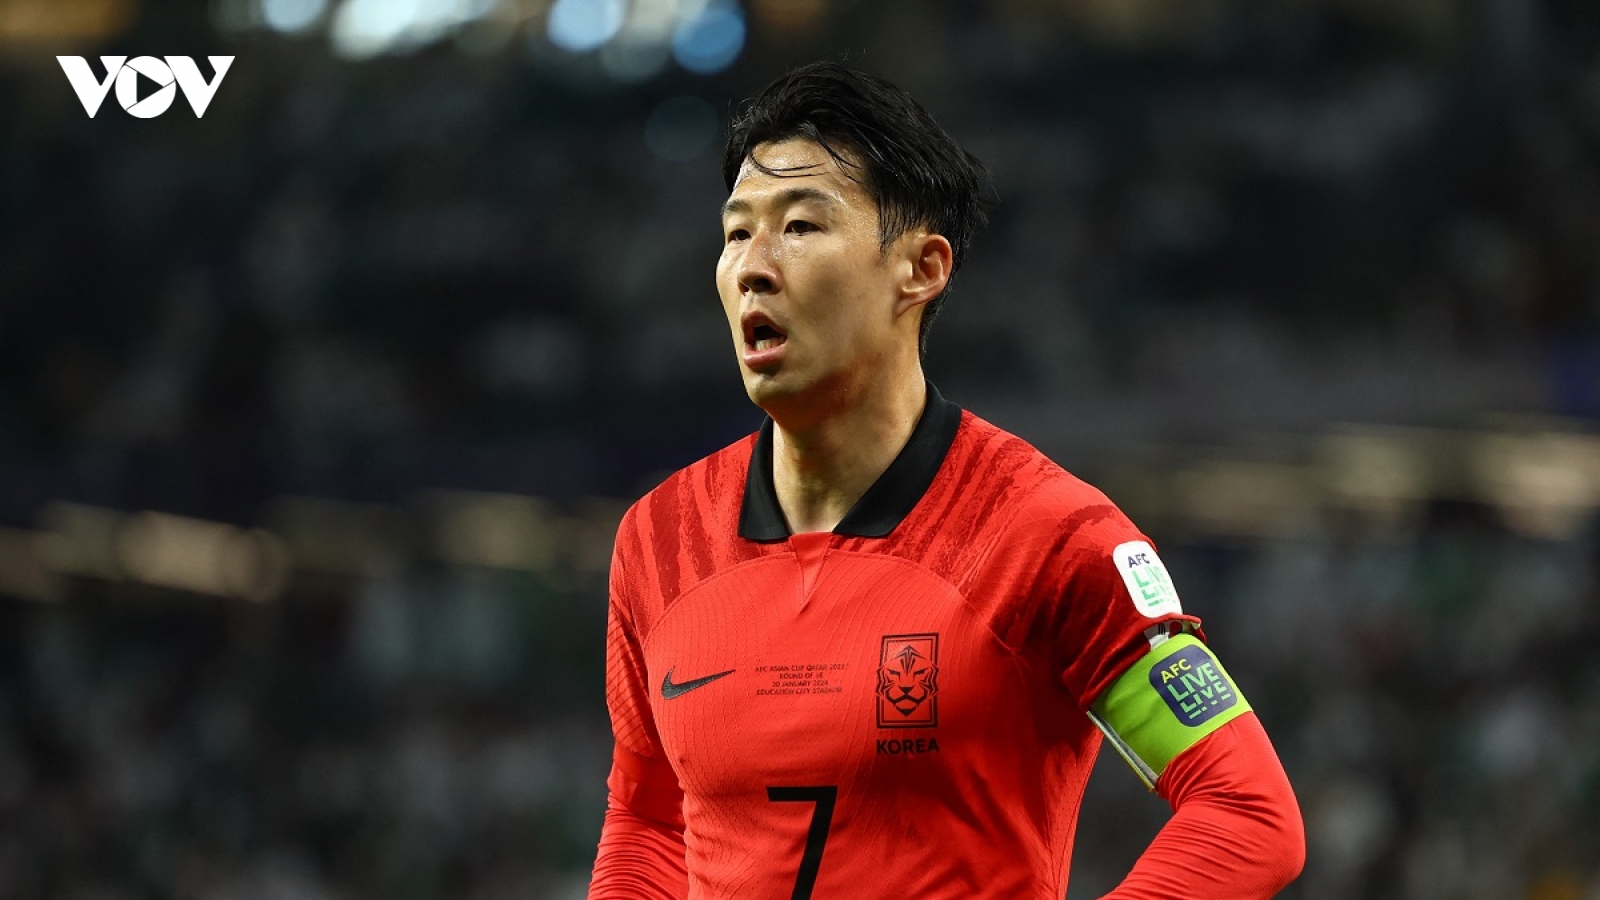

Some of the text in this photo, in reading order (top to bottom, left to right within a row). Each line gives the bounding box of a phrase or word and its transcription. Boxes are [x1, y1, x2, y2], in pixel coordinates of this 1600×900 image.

[1128, 553, 1150, 568] AFC
[1161, 659, 1192, 684] AFC
[1167, 663, 1219, 701] LIVE
[877, 738, 939, 753] KOREA
[766, 786, 838, 900] 7
